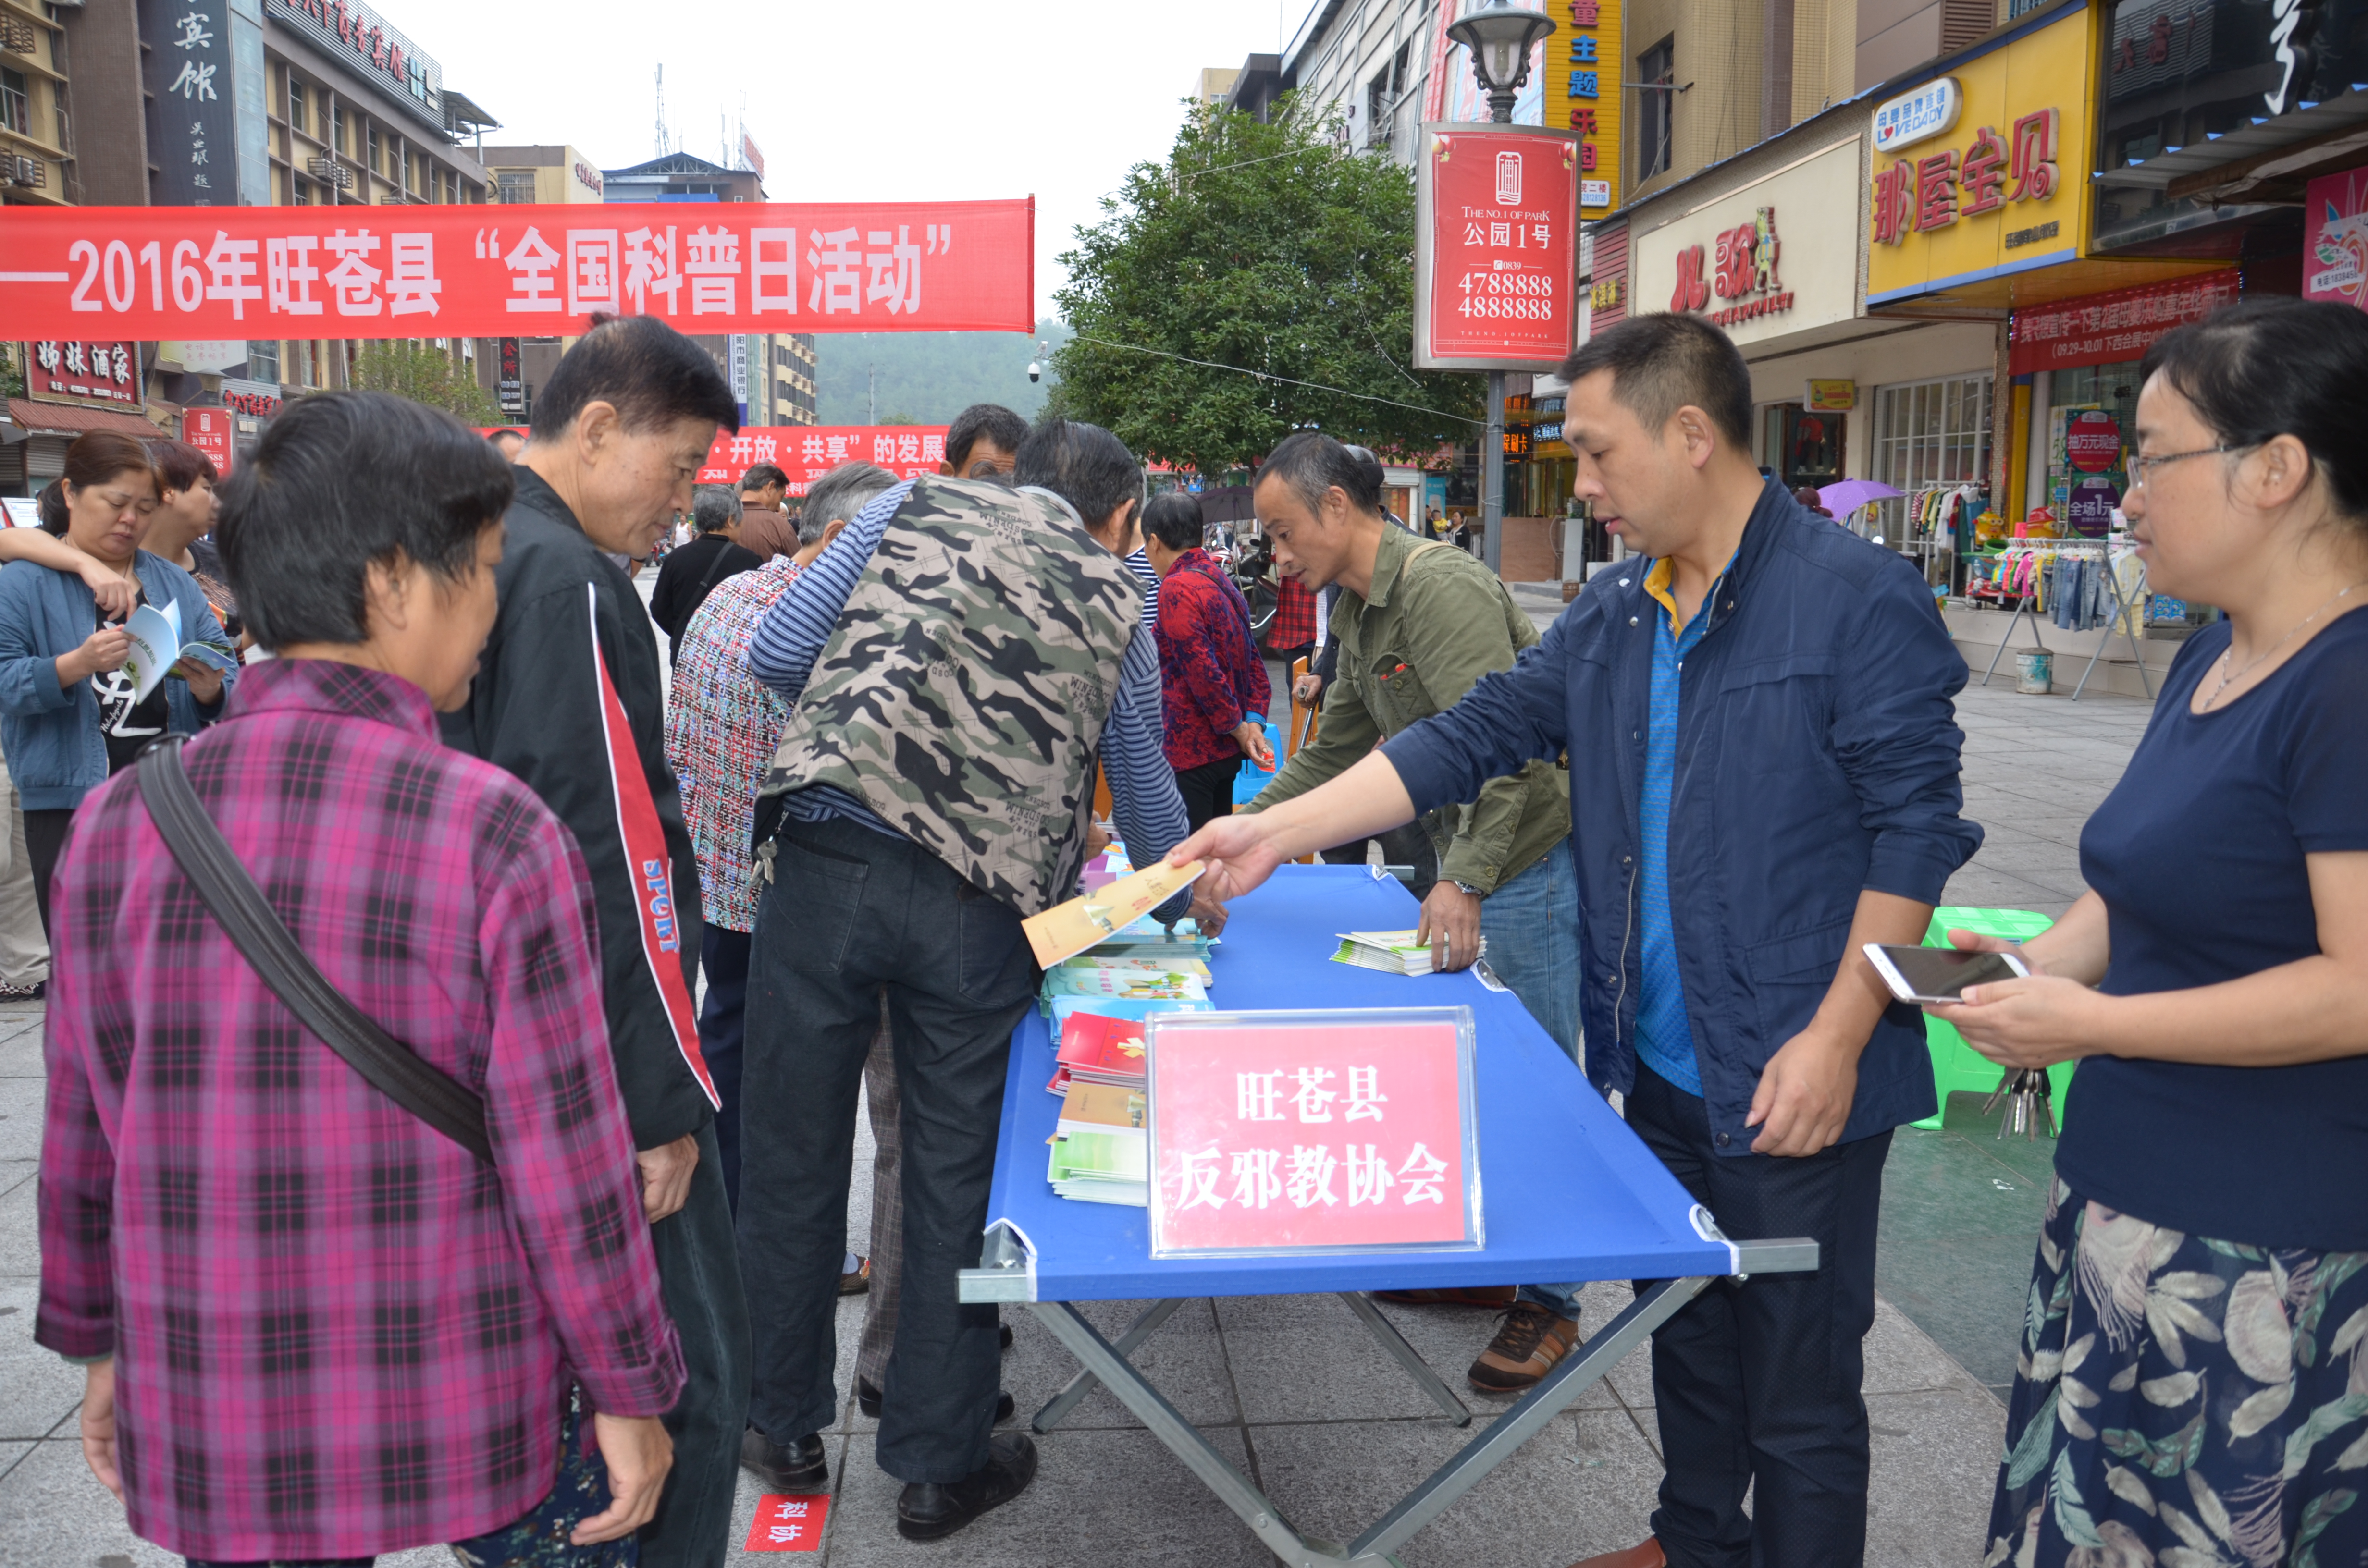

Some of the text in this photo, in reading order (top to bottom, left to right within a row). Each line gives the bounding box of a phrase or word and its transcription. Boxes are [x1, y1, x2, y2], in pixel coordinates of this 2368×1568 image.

[1581, 193, 1606, 202] 28128136
[1461, 206, 1484, 218] THE
[1510, 211, 1523, 219] OF
[1525, 210, 1550, 221] PARK
[1463, 222, 1551, 249] 公园1号
[1503, 261, 1522, 270] 0839
[1670, 223, 1755, 313] 儿歌
[1458, 272, 1552, 296] 4788888
[1458, 296, 1552, 320] 4888888
[2068, 434, 2119, 450] 抽万元现金
[1236, 1065, 1388, 1123] 旺苍县
[1174, 1142, 1449, 1210] 反邪教协会
[769, 1502, 808, 1543] 科协
